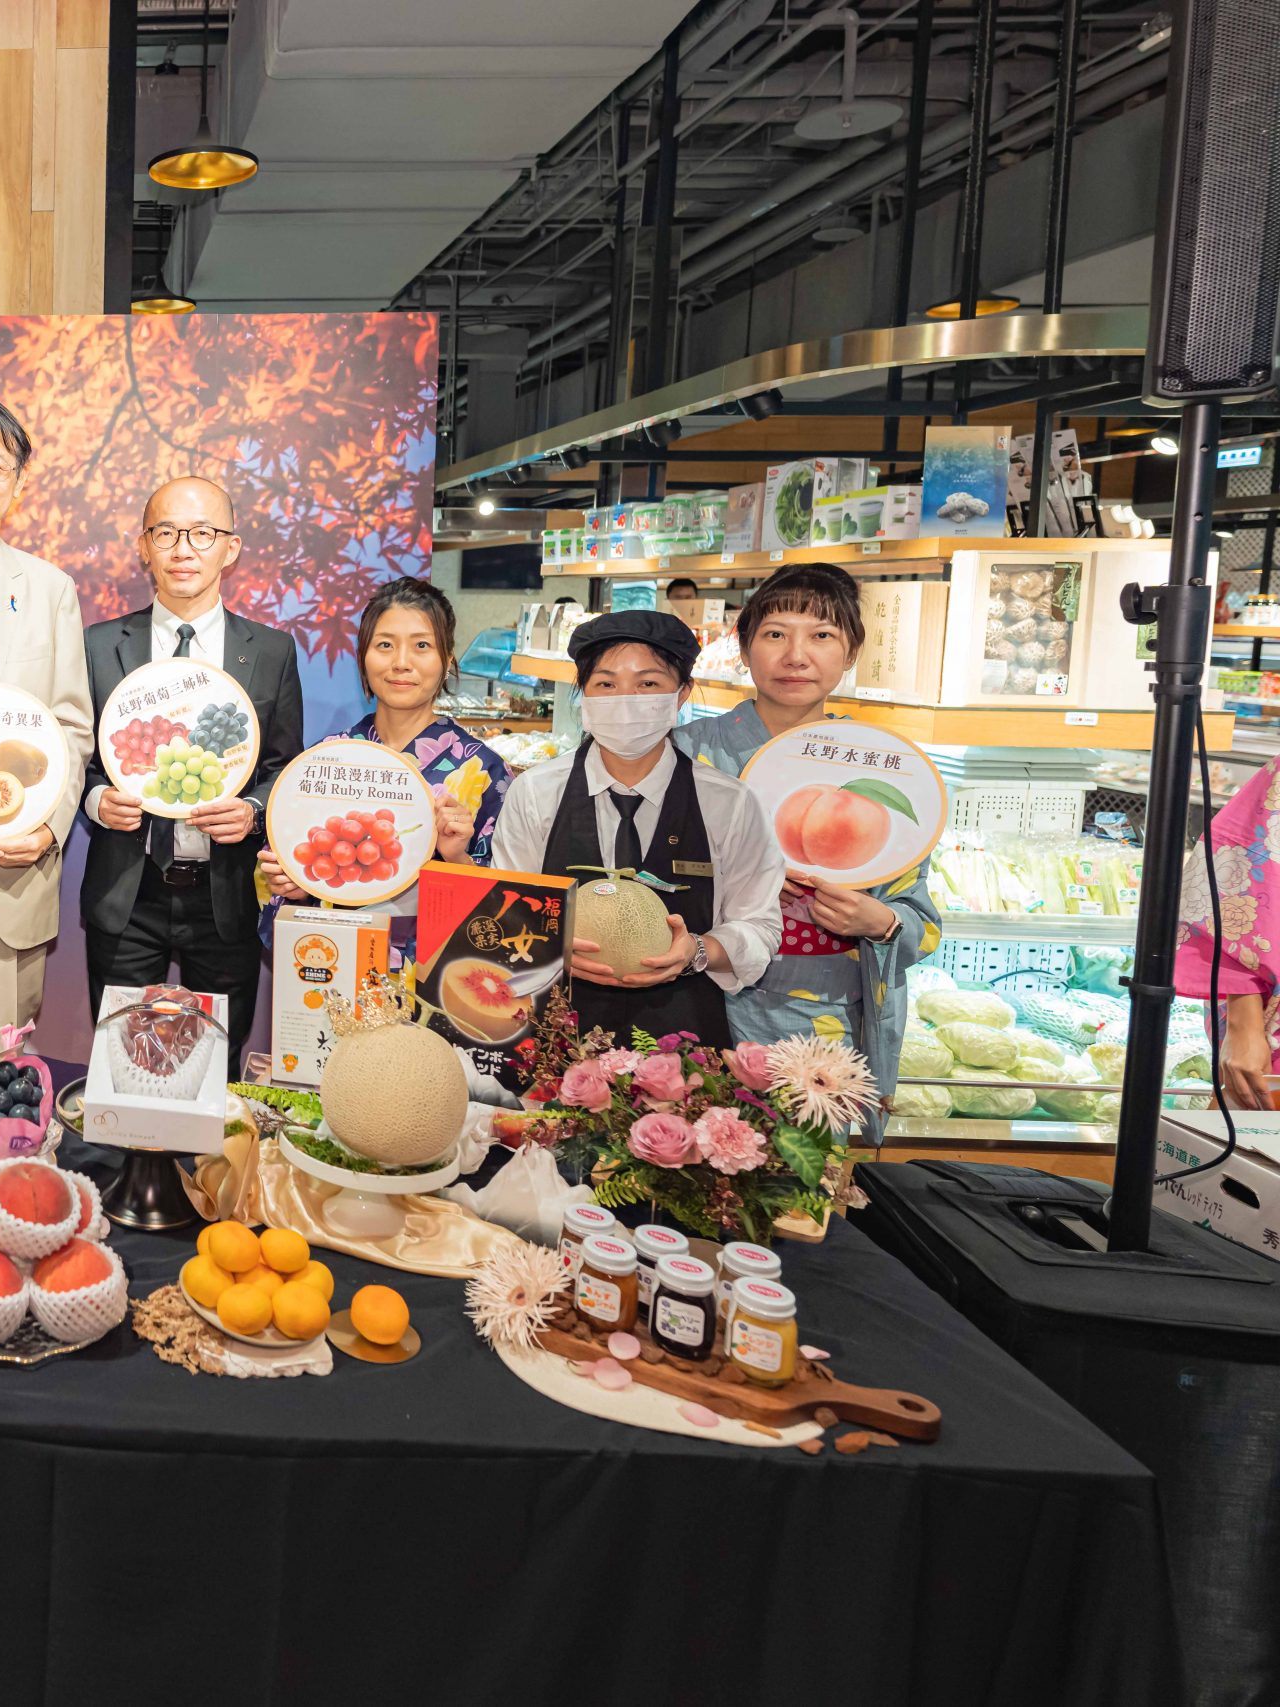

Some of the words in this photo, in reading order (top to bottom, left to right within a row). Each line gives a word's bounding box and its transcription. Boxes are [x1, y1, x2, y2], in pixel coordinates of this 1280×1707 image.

[801, 741, 902, 770] 長野水蜜桃
[303, 764, 410, 787] 石川浪漫紅寶石
[298, 779, 326, 795] 葡萄
[331, 783, 364, 800] Ruby
[367, 786, 414, 801] Roman
[464, 1046, 513, 1064] インボー
[476, 1063, 502, 1076] ッド
